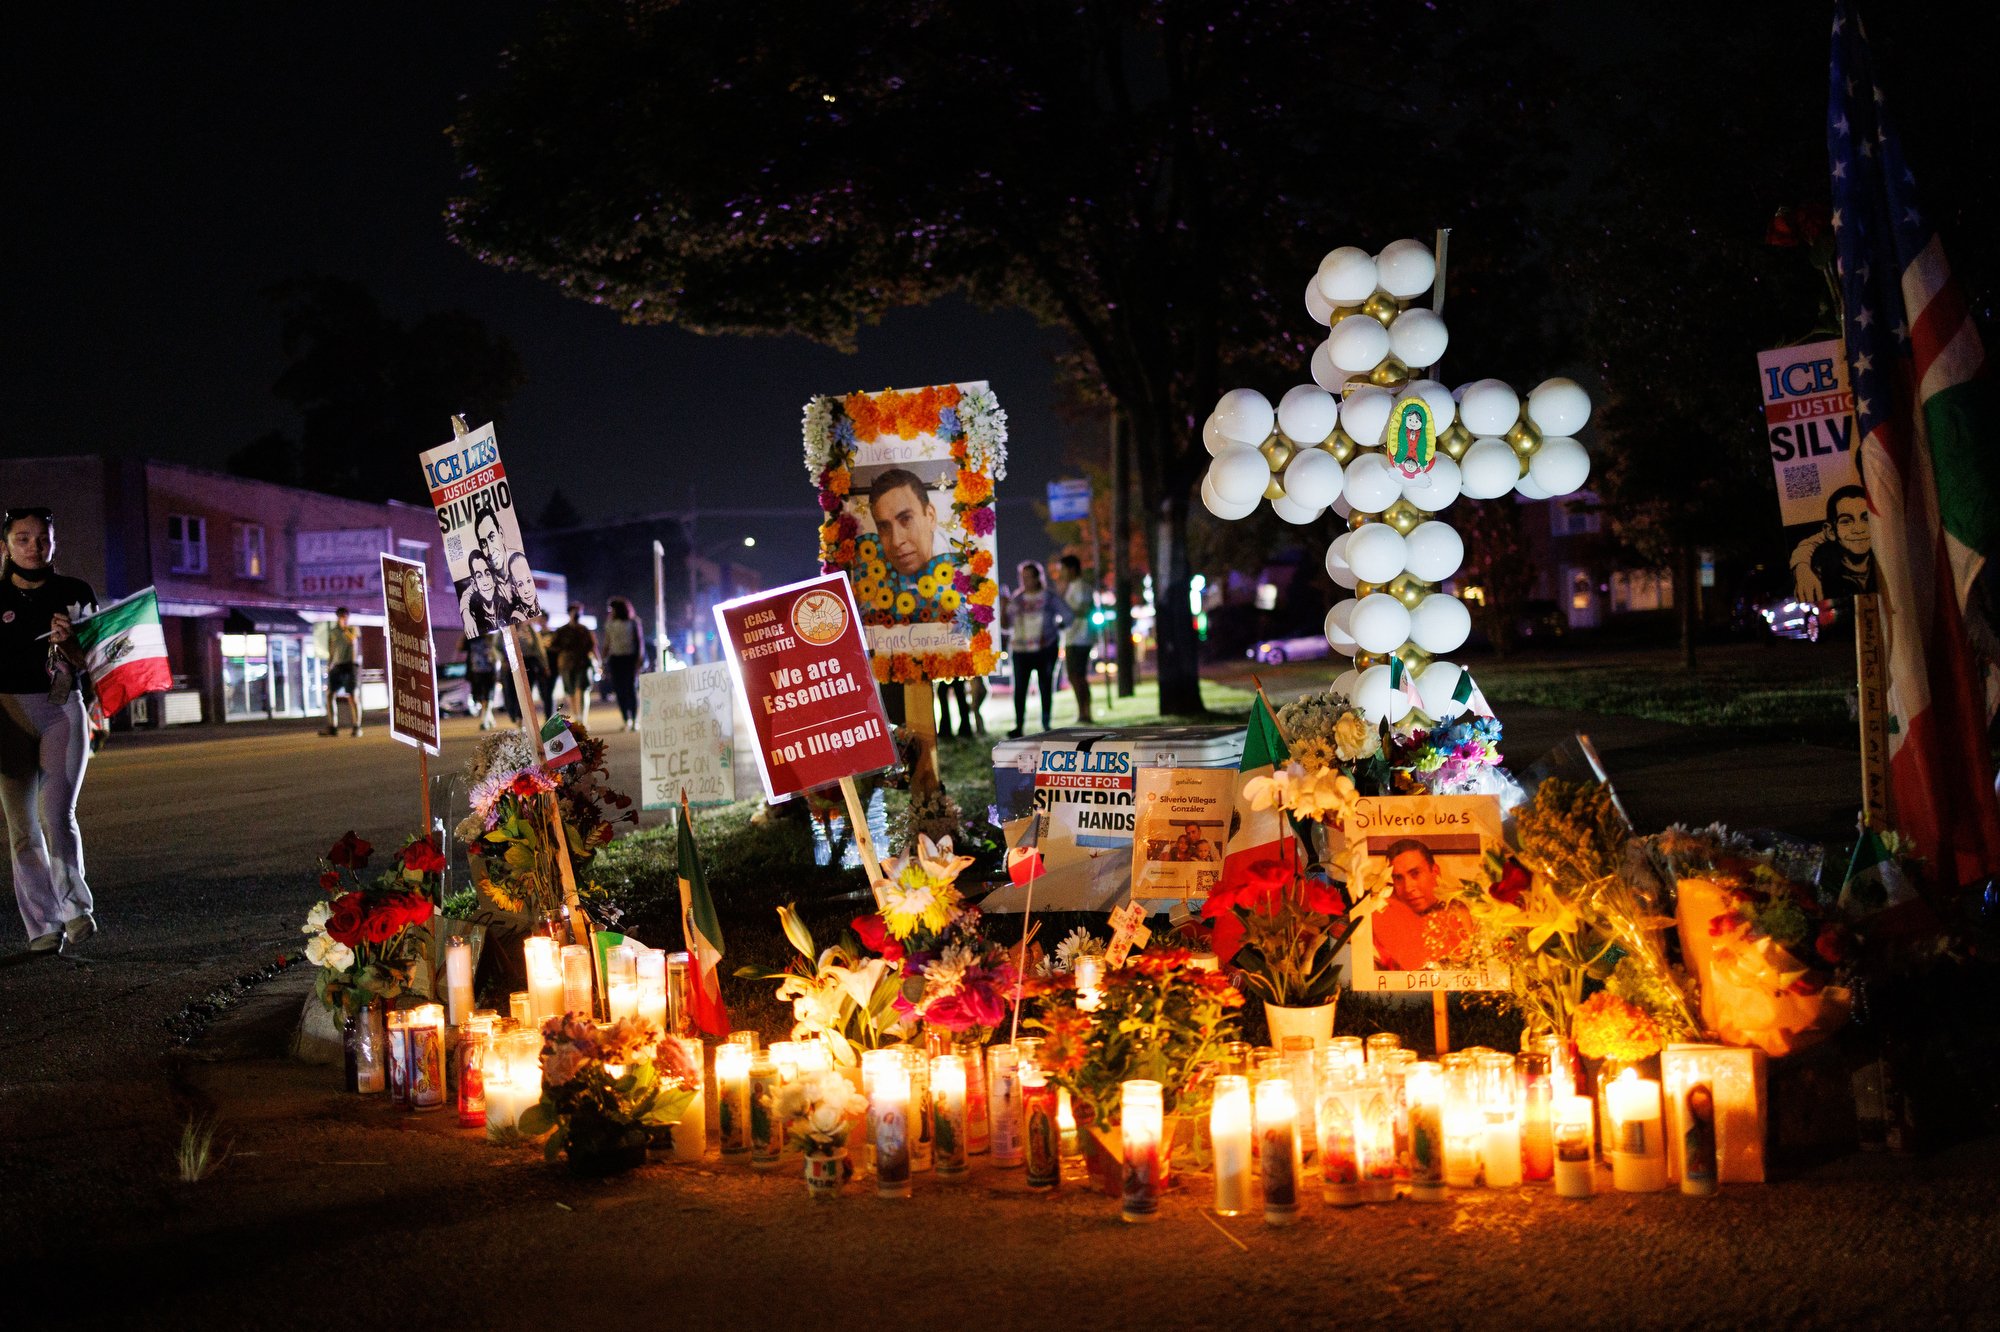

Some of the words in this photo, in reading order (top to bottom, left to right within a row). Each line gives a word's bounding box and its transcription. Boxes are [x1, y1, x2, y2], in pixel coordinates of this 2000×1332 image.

[1765, 358, 1838, 400] ICE
[1786, 393, 1855, 419] JUSTIC
[1770, 416, 1853, 462] SILV
[425, 453, 462, 489] ICE
[462, 436, 497, 475] LIES
[443, 479, 477, 501] JUSTICE
[478, 468, 496, 487] FOR
[437, 481, 512, 534] SILVERIO
[302, 573, 365, 592] SIGN
[743, 609, 776, 629] ¡CASA
[743, 623, 785, 644] DUPAGE
[395, 647, 430, 675] Existencia
[741, 636, 796, 661] PRESENTE!
[769, 668, 803, 690] We
[807, 657, 841, 681] are
[398, 689, 421, 713] Espera
[422, 700, 431, 717] mi
[762, 673, 861, 715] Essential,
[395, 707, 436, 738] Resistencia
[642, 726, 677, 750] KILLED
[683, 721, 707, 742] HERE
[711, 719, 723, 740] BY
[771, 740, 806, 766] not
[807, 718, 881, 756] Illegal!
[650, 751, 690, 781] ICE
[693, 756, 710, 774] ON
[1039, 750, 1077, 772] ICE
[1081, 751, 1130, 774] LIES
[656, 779, 680, 800] SEPT
[699, 776, 725, 796] 2025
[1046, 775, 1092, 787] JUSTICE
[1095, 777, 1120, 788] FOR
[1160, 795, 1187, 804] Silverio
[1188, 796, 1217, 806] Villegas
[1171, 805, 1205, 813] González
[1354, 799, 1426, 828] Silverio
[1434, 812, 1471, 825] was
[1078, 811, 1135, 831] HANDS
[1378, 975, 1387, 990] A
